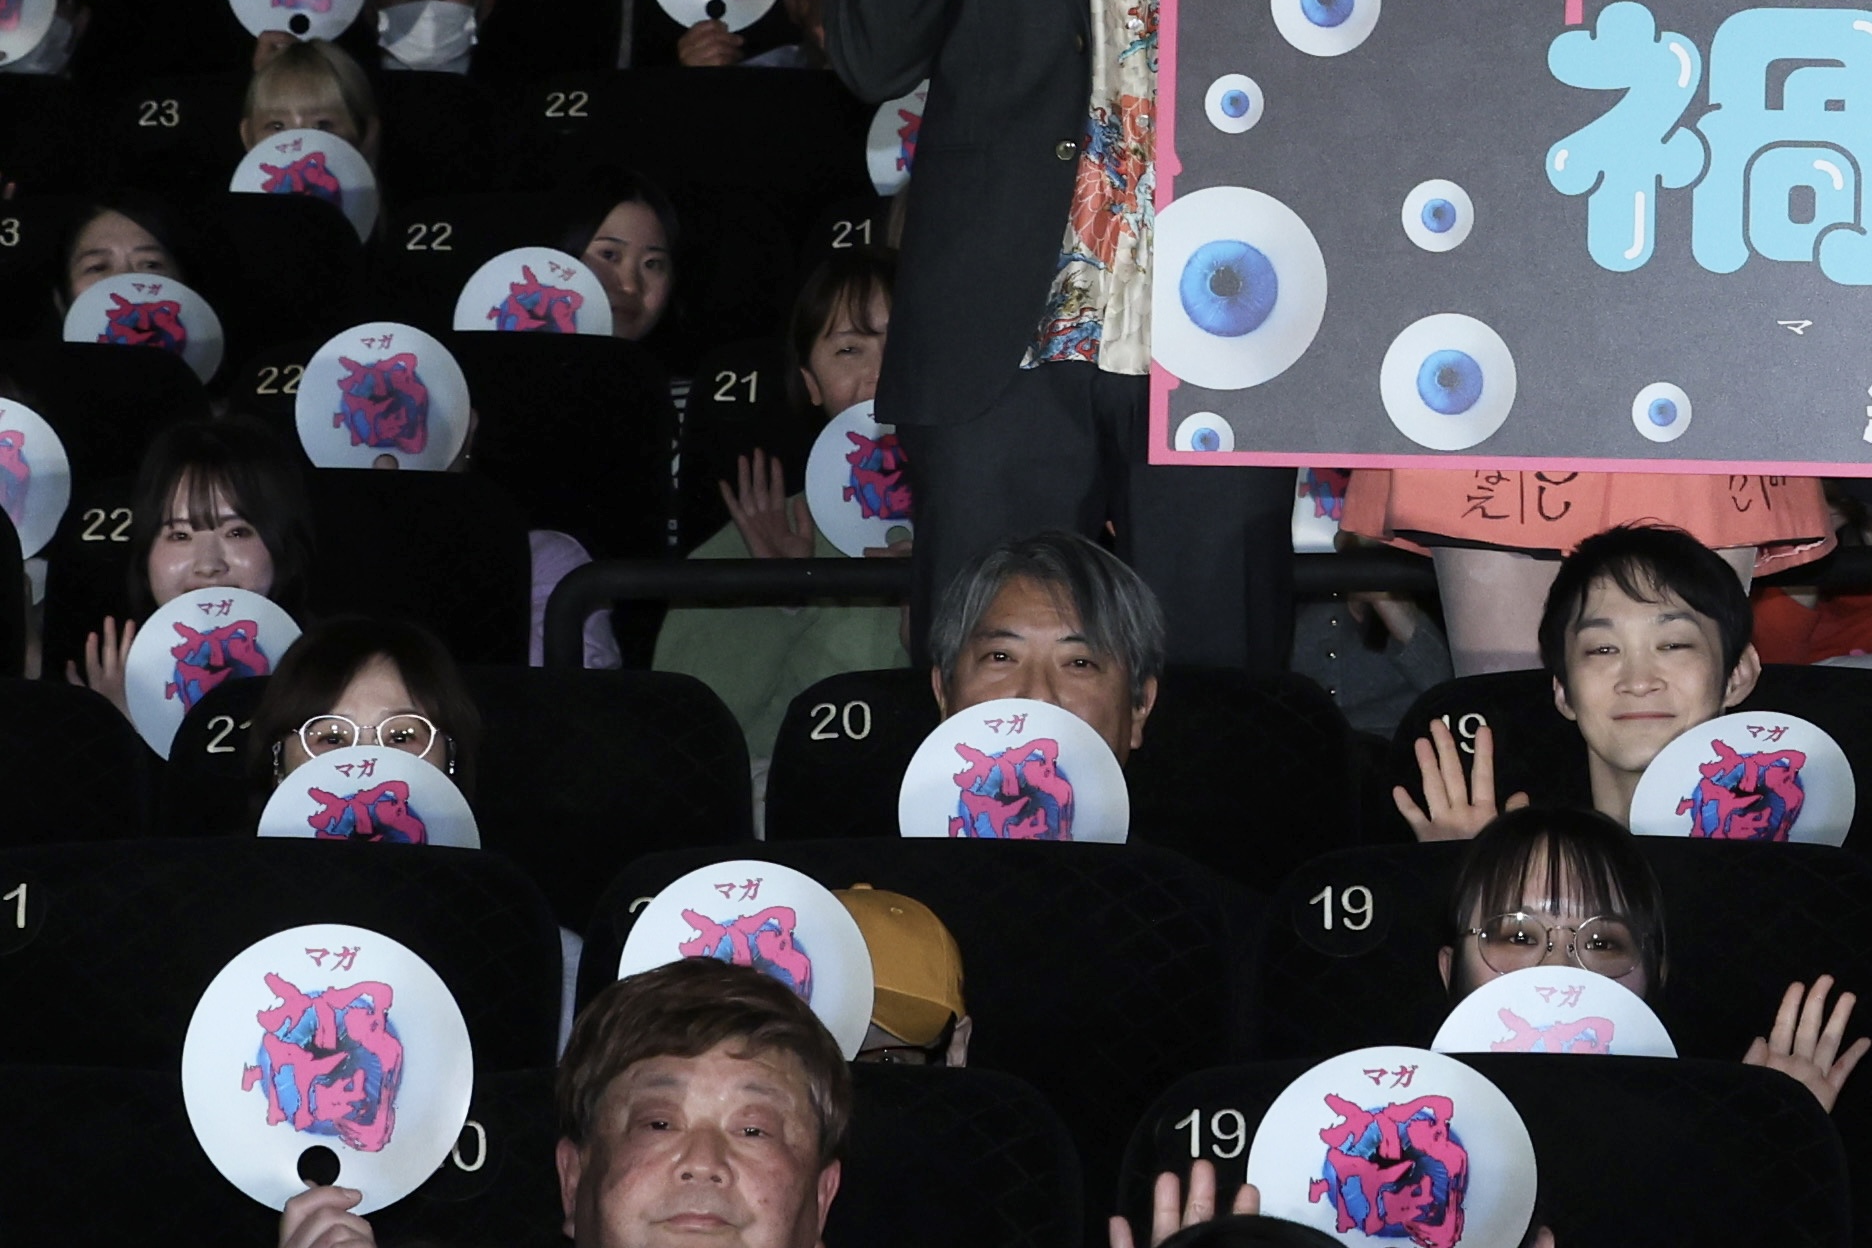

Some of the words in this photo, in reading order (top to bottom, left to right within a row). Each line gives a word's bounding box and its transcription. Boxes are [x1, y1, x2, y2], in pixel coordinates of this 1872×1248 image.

[137, 99, 180, 127] 23
[544, 90, 589, 118] 22
[0, 217, 20, 247] 3
[405, 222, 453, 251] 22
[831, 218, 872, 249] 21
[360, 334, 394, 349] マガ
[256, 365, 307, 398] 22
[713, 370, 758, 404] 21
[81, 507, 133, 542] 22
[197, 599, 234, 616] マガ
[205, 714, 251, 754] 2
[810, 700, 872, 741] 20
[984, 713, 1028, 735] マガ
[1747, 725, 1789, 742] マガ
[335, 758, 378, 778] マガ
[714, 878, 763, 901] マガ
[2, 882, 28, 929] 1
[1308, 885, 1374, 931] 19
[305, 946, 361, 971] マガ
[1534, 985, 1586, 1008] マガ
[1363, 1065, 1418, 1088] マガ
[455, 1119, 488, 1172] 0
[1173, 1108, 1246, 1159] 19
